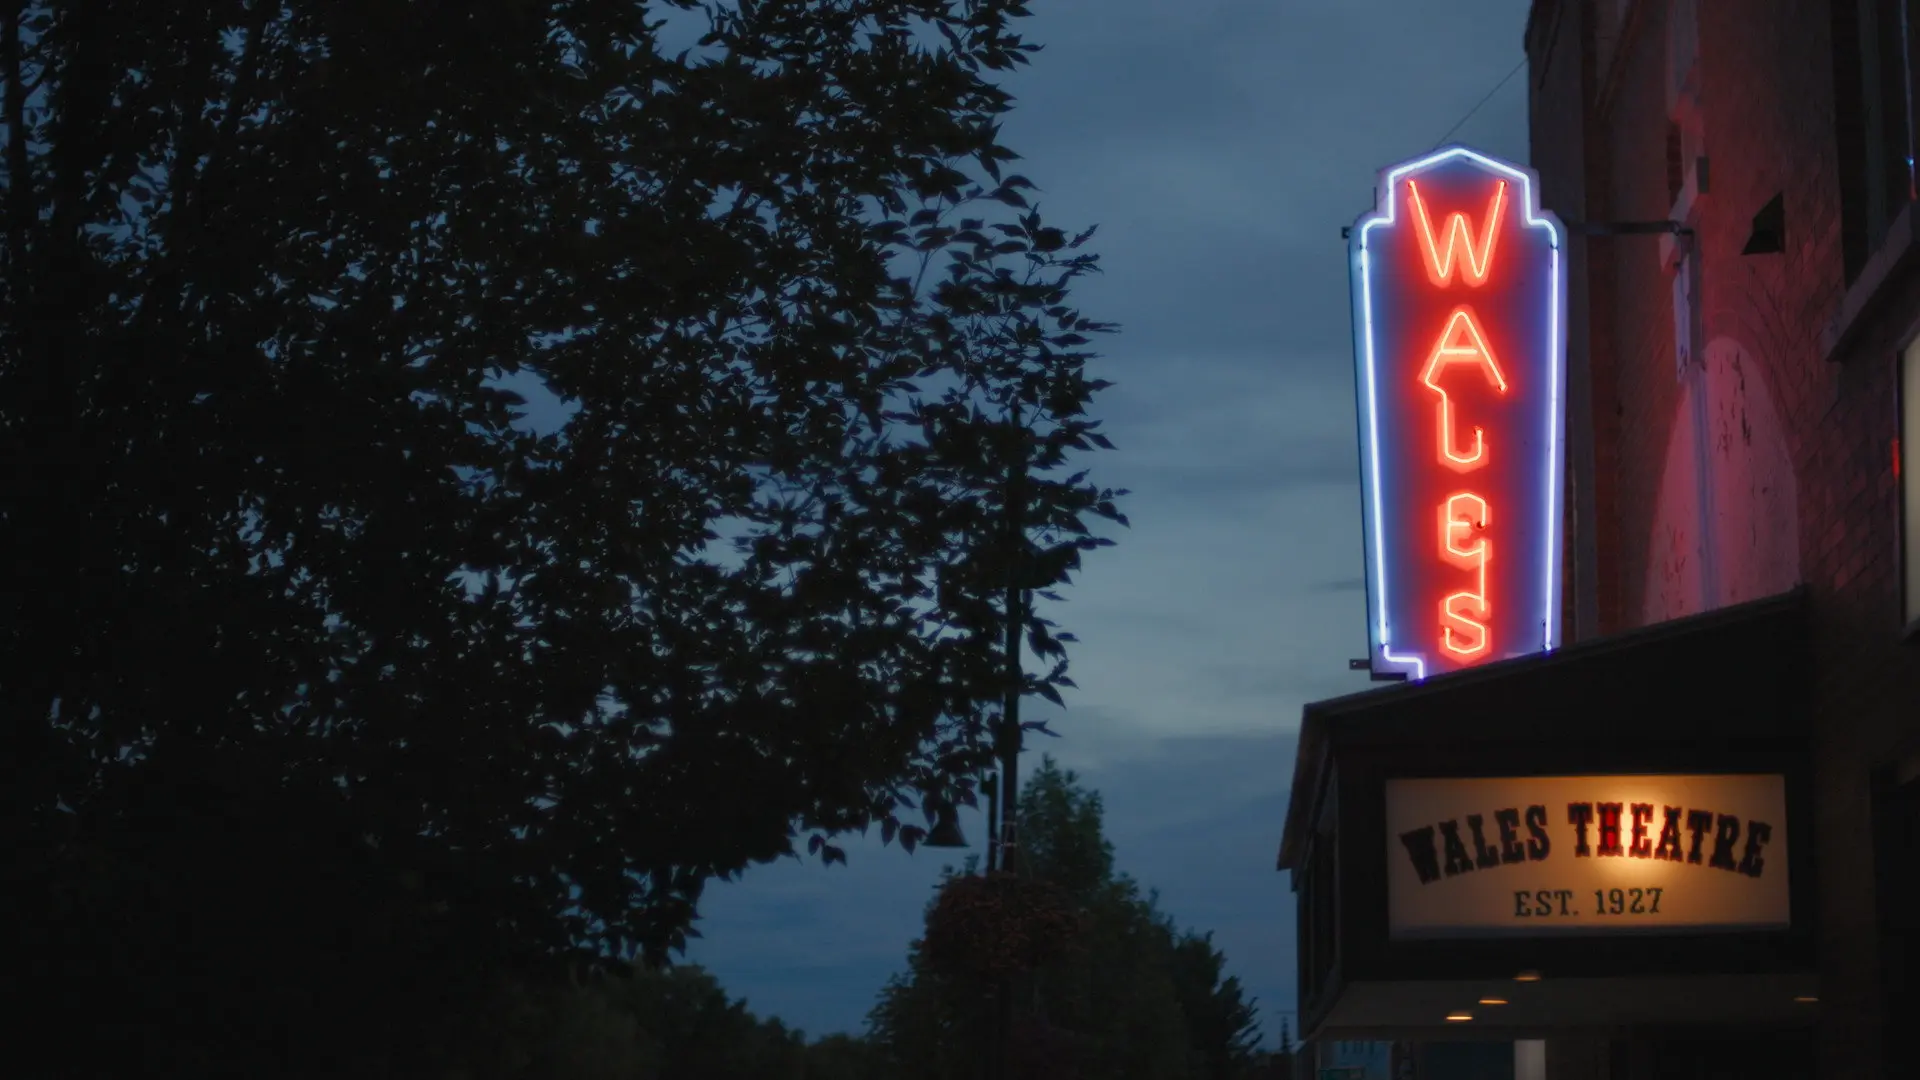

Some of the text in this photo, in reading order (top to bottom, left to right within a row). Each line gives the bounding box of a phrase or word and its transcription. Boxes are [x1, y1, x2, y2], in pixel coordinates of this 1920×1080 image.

[1407, 179, 1508, 659] WALES
[1400, 802, 1772, 884] WALES THEATRE
[1514, 888, 1664, 917] EST. 1927
